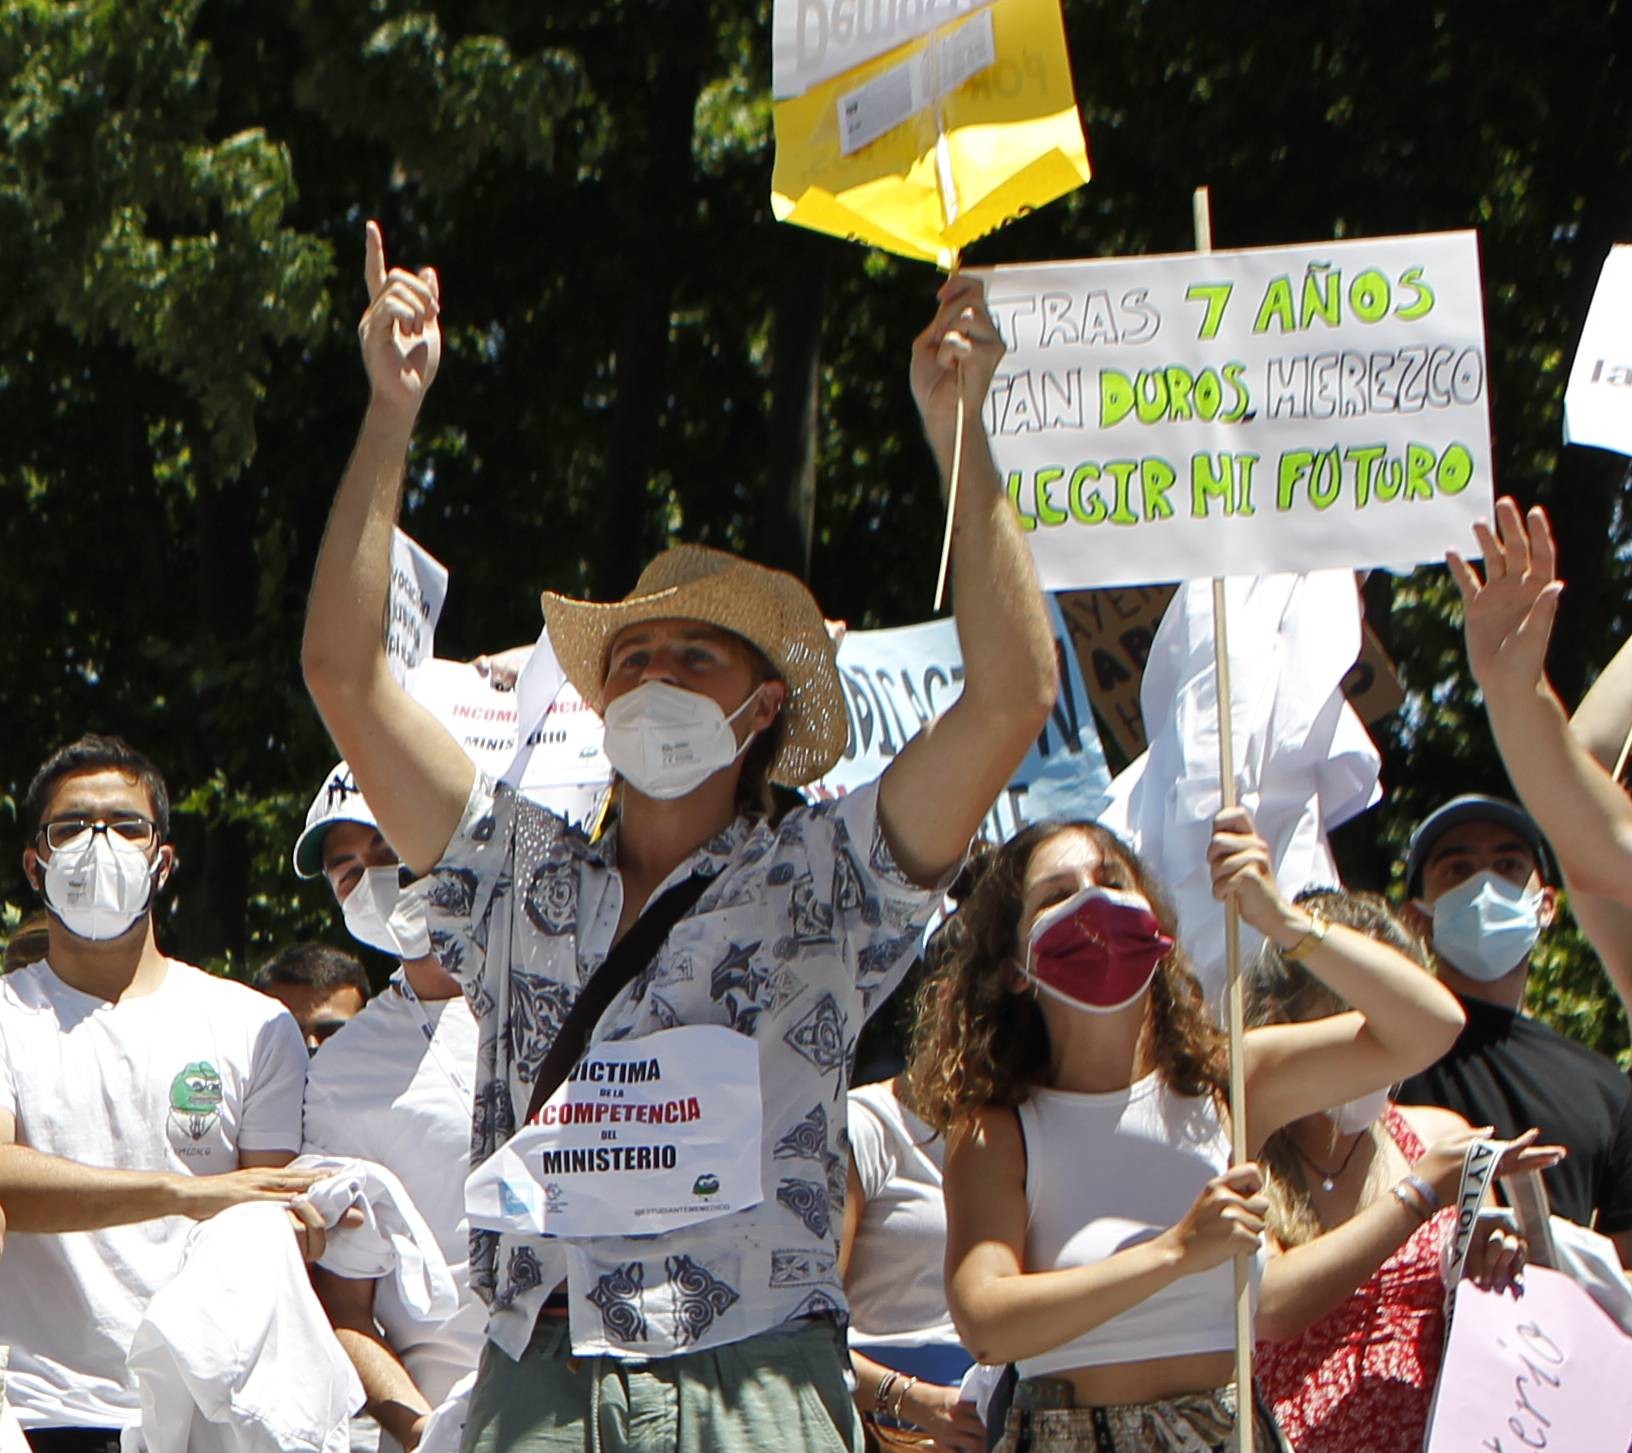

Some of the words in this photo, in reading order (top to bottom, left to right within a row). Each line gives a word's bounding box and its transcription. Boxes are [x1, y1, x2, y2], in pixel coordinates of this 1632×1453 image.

[990, 287, 1161, 353] TRAS
[1185, 281, 1234, 341] 7
[1253, 261, 1436, 335] AÑOS
[1266, 345, 1484, 422] MEREZCO
[1006, 455, 1176, 532] LEGIR
[1189, 452, 1259, 520] MI
[1277, 441, 1475, 512] FUTURO
[542, 1145, 677, 1174] MINISTERIO
[601, 1130, 617, 1140] DEL
